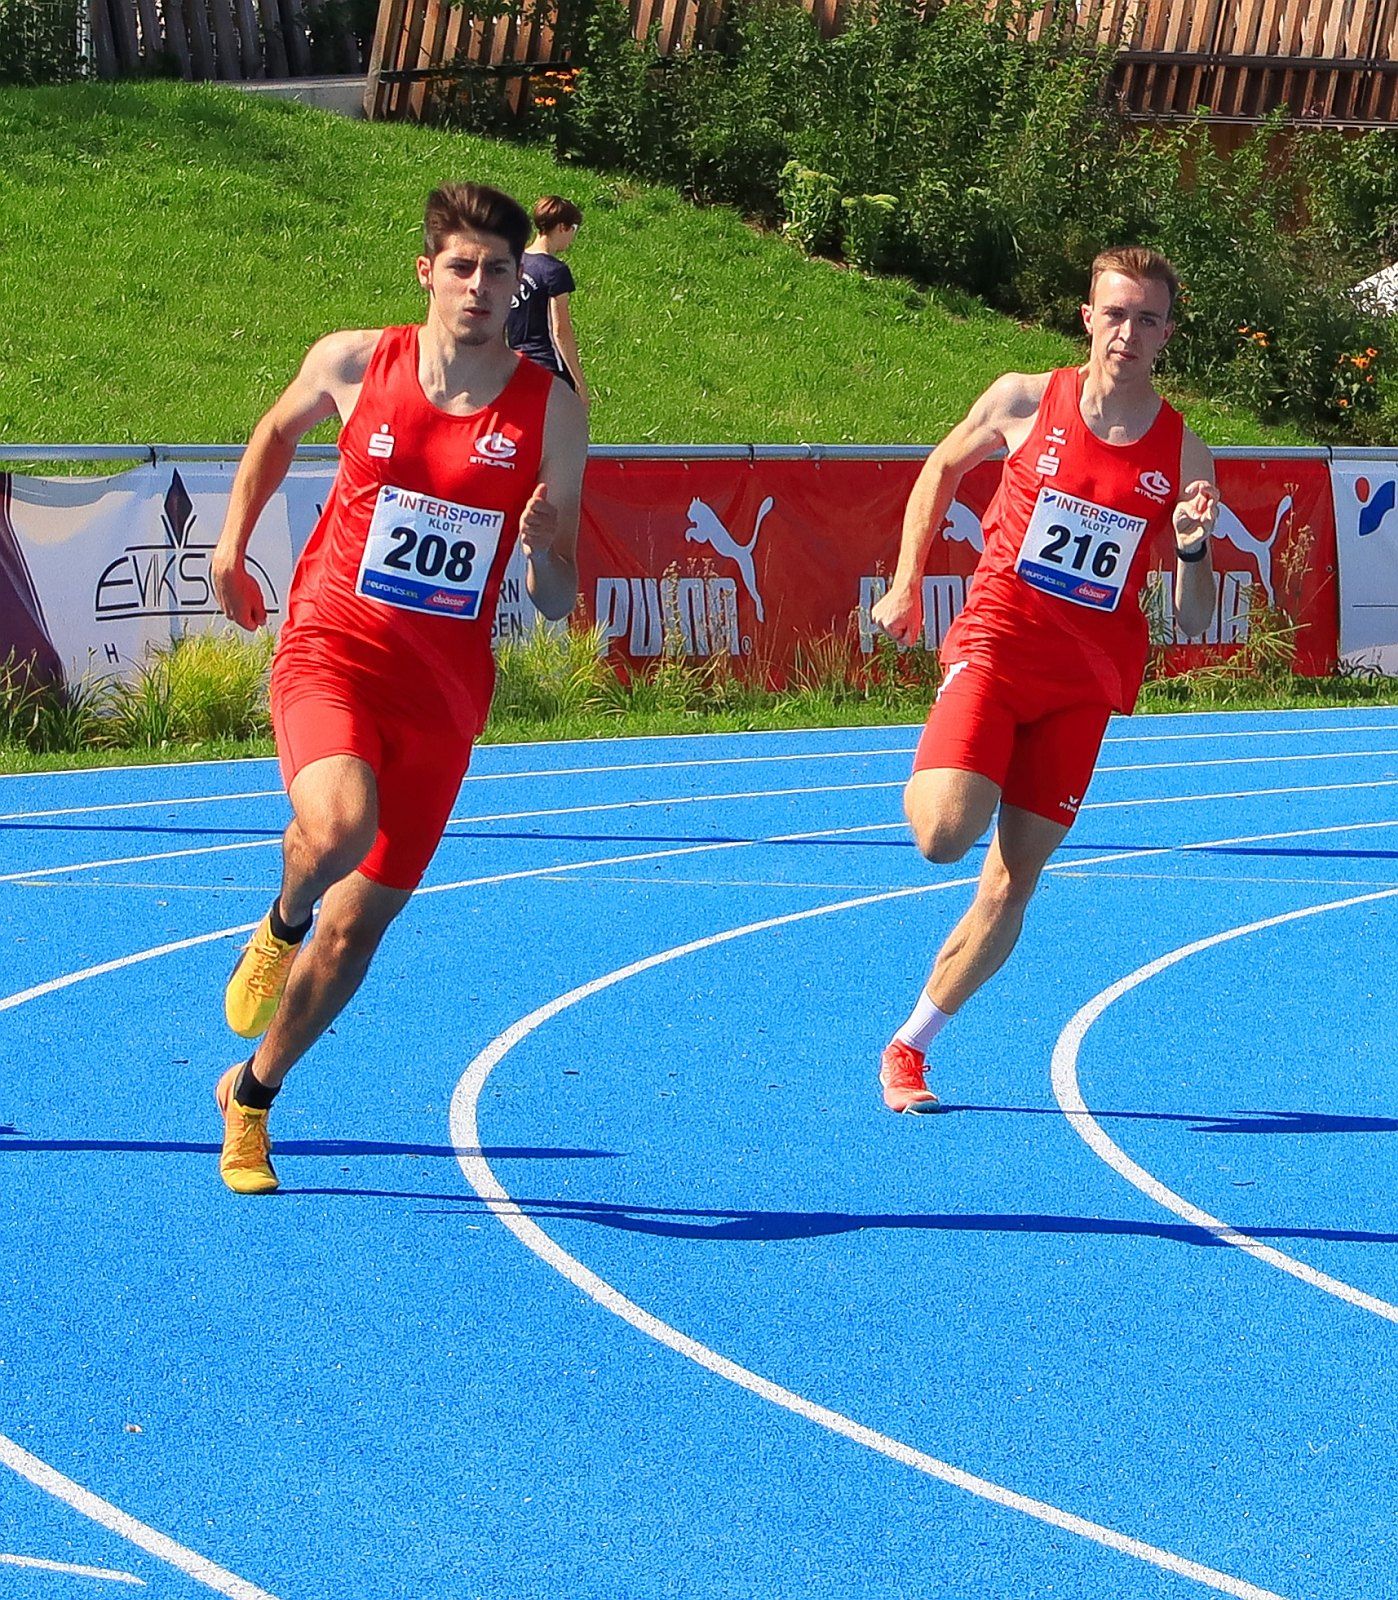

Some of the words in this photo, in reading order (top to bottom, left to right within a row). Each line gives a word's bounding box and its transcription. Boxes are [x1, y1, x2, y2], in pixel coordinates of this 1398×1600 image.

[399, 494, 502, 528] INTERSPORT
[428, 518, 464, 535] KLOTZ
[1056, 496, 1145, 533] INTERSPORT
[1081, 519, 1111, 536] KLOTZ
[383, 526, 476, 583] 208
[1038, 524, 1121, 578] 216
[596, 577, 740, 656] PUMA
